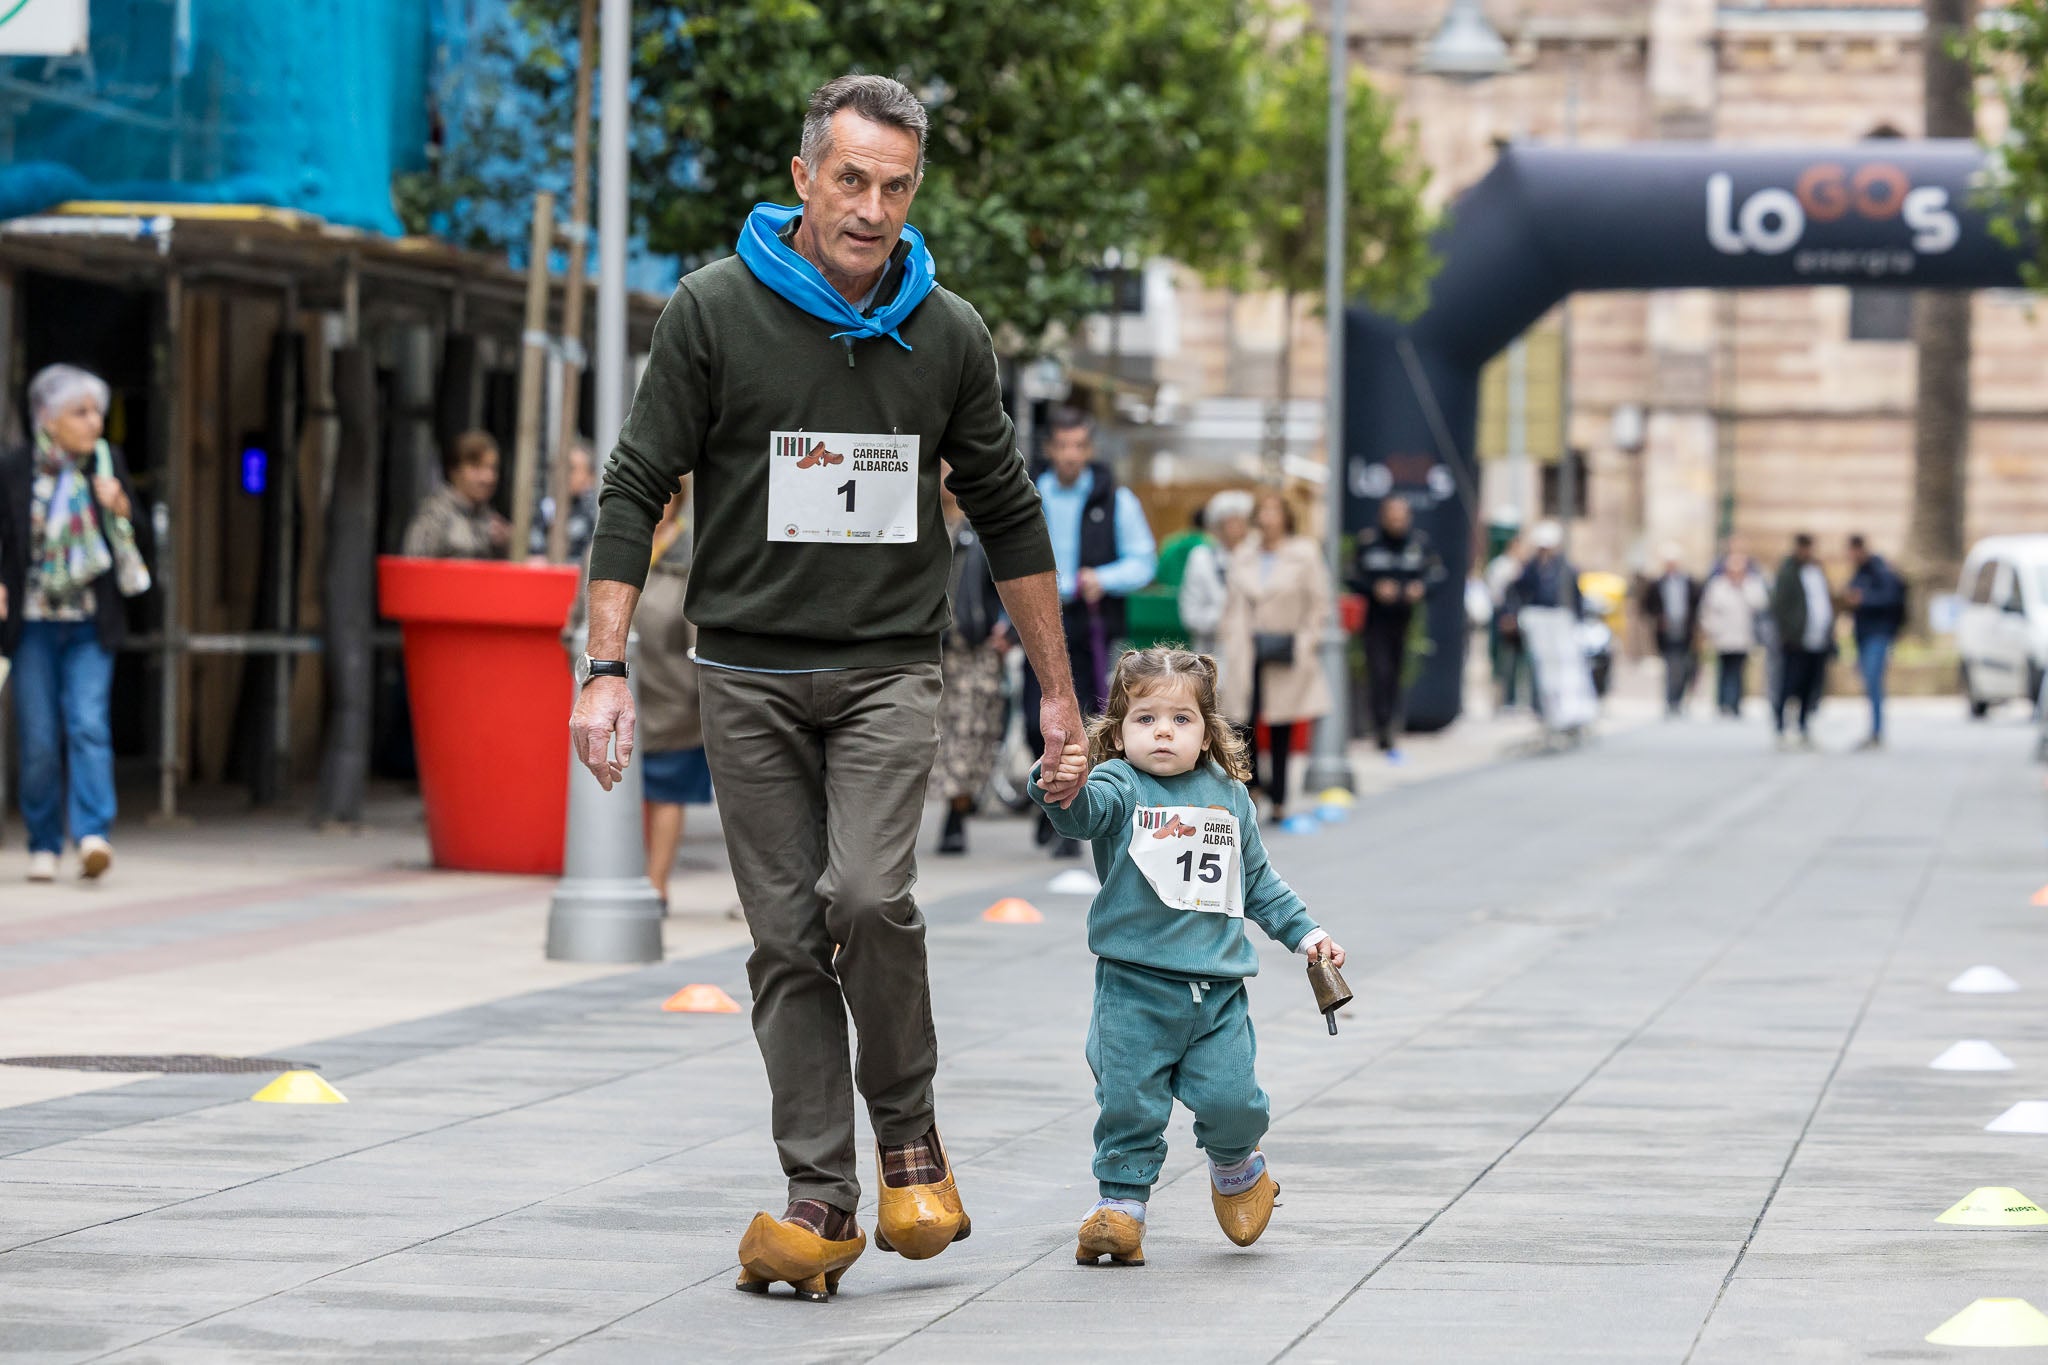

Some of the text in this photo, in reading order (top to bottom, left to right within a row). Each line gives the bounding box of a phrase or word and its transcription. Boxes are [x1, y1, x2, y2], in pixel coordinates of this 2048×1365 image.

[853, 448, 899, 459] CARRERA
[853, 460, 909, 472] ALBARCAS
[838, 480, 856, 512] 1
[1176, 850, 1222, 884] 15
